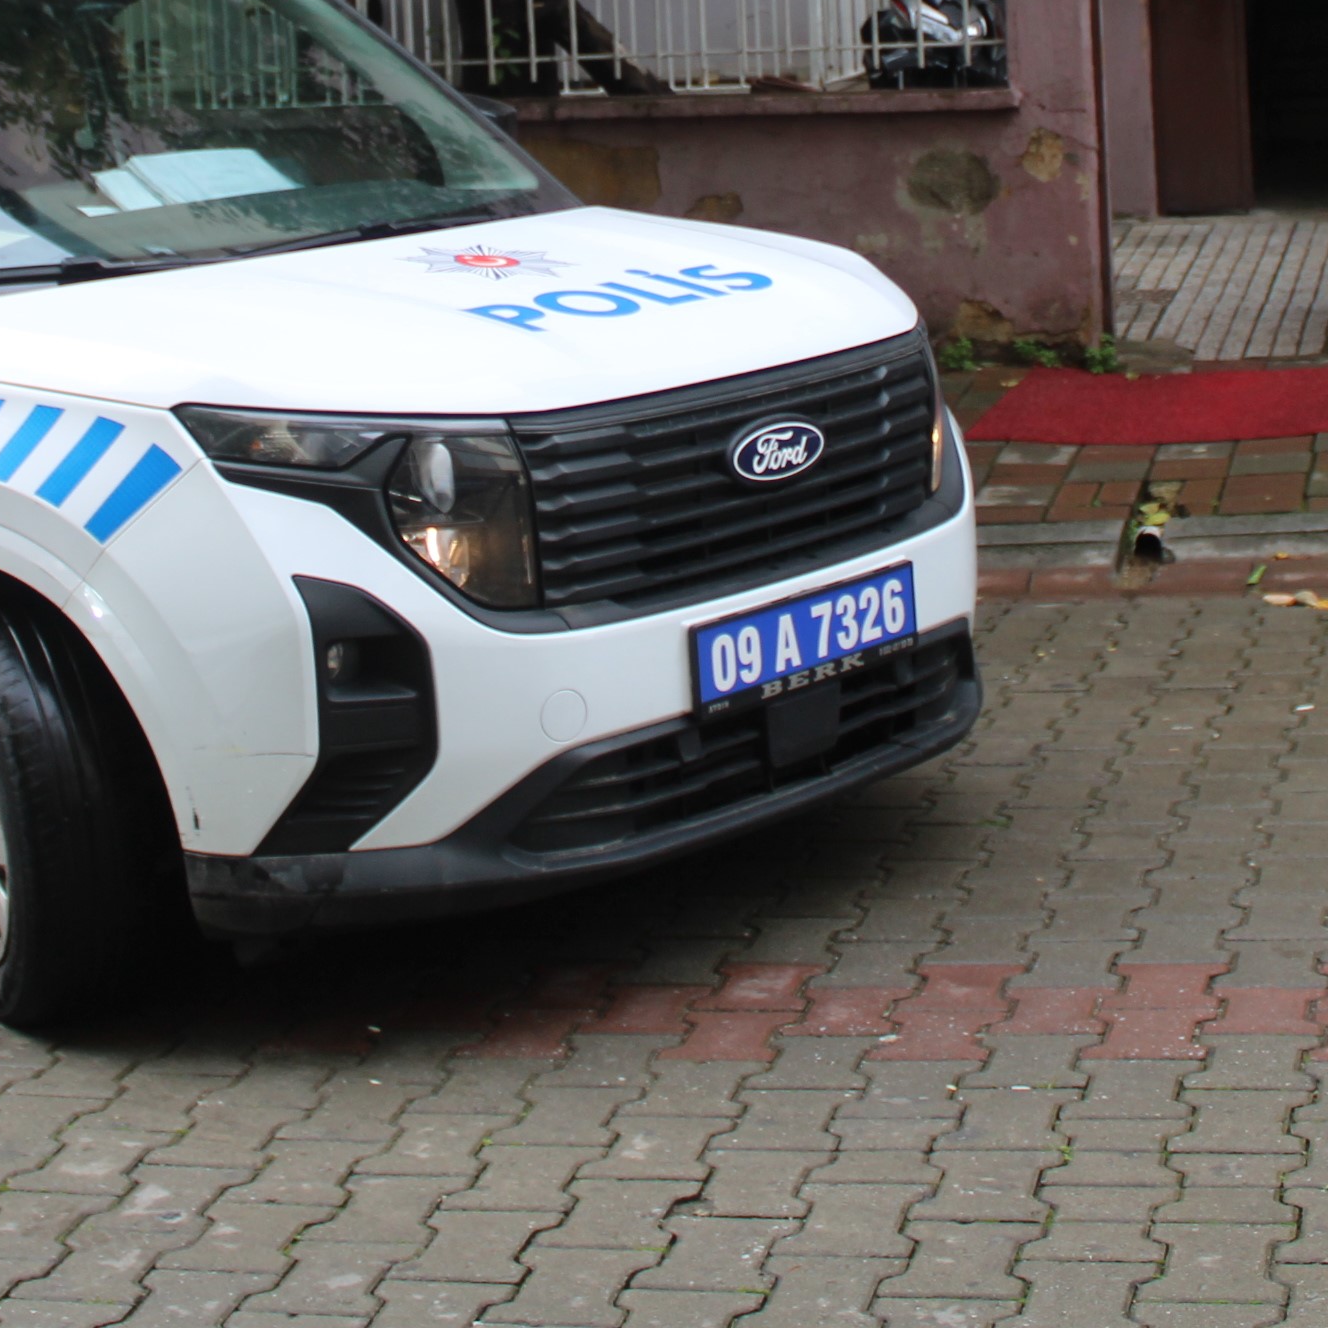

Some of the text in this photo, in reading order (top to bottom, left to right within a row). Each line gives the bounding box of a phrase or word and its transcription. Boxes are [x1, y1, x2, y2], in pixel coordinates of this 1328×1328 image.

[458, 263, 773, 332] POLİS
[752, 430, 808, 474] Ford
[711, 578, 906, 693] 09 A 7326
[760, 651, 866, 700] BERK
